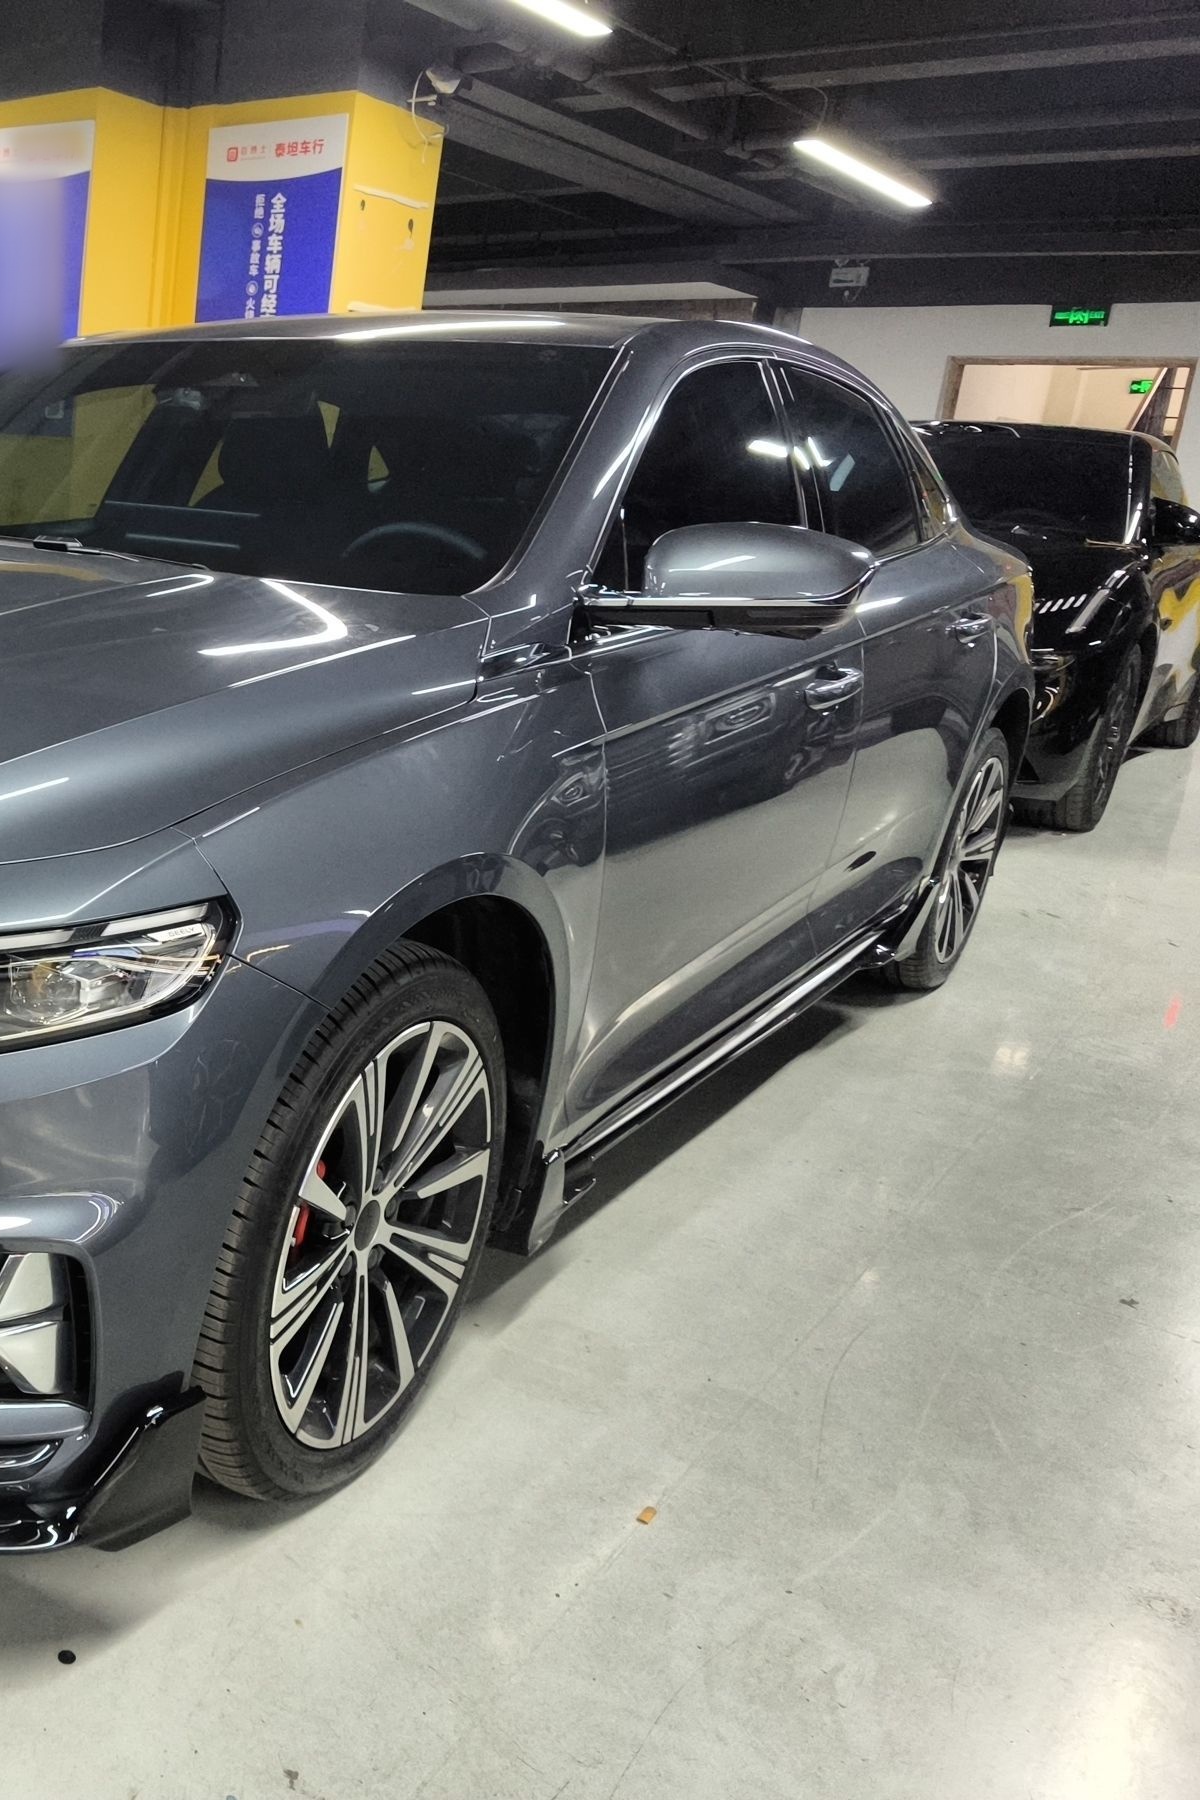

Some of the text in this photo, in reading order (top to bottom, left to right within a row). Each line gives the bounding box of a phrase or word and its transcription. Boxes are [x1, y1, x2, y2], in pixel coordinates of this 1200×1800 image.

[275, 139, 324, 158] 泰坦车行
[260, 192, 287, 317] 全场车辆可经
[168, 926, 195, 938] GEELY
